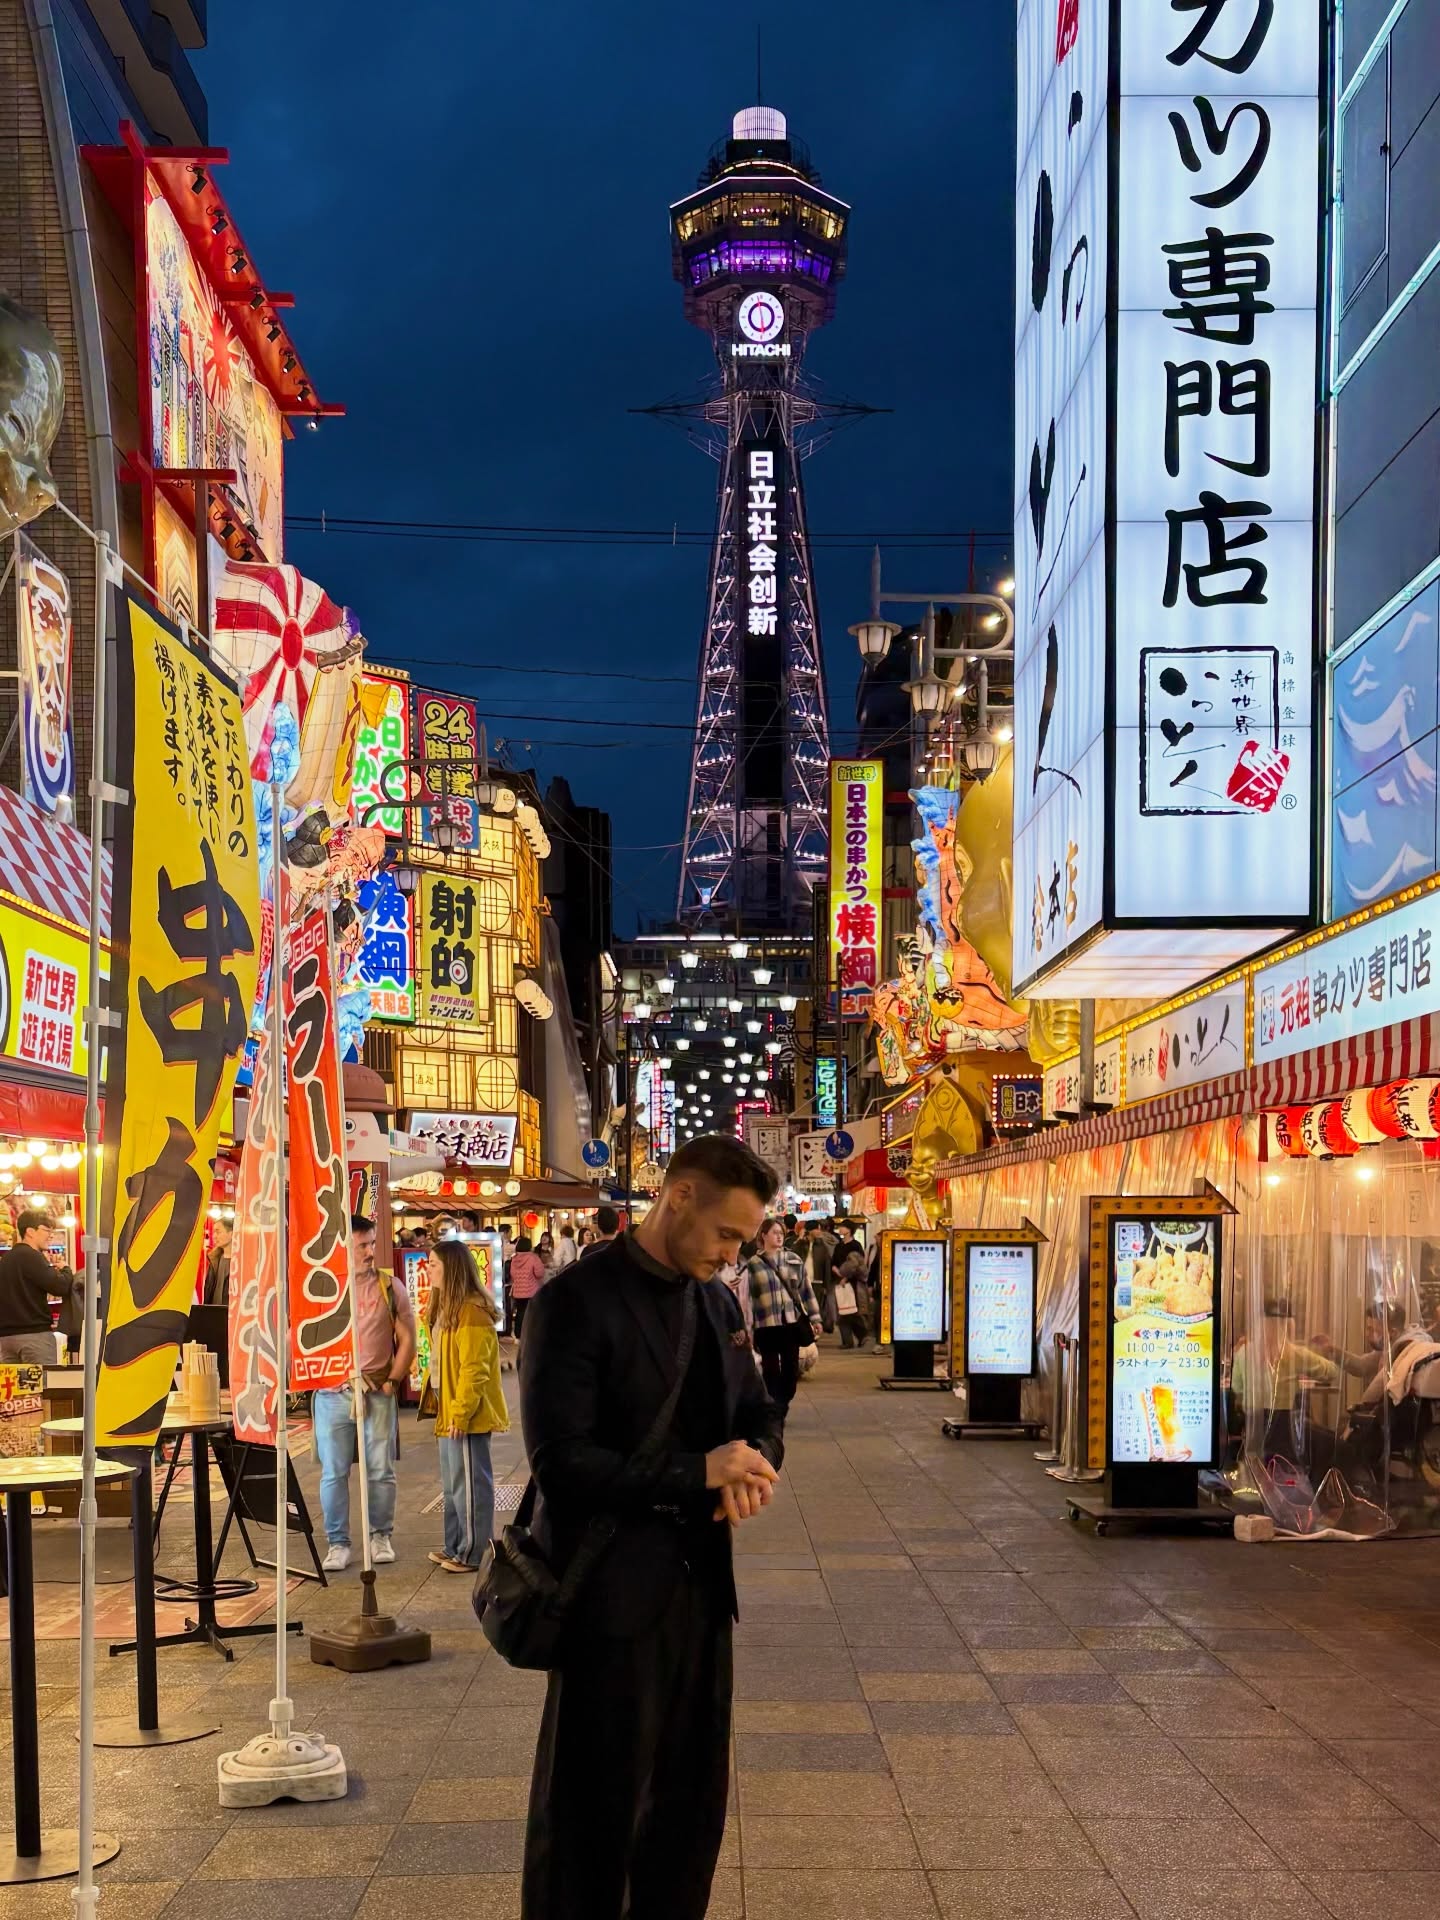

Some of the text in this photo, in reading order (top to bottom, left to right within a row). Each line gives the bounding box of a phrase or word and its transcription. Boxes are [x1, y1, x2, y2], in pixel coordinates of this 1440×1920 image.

[1161, 0, 1275, 607] カツ専門店
[731, 343, 790, 356] HITACHI
[748, 451, 777, 636] 日立社会创新
[154, 638, 186, 806] 揚げます。
[424, 700, 474, 743] 24
[1230, 669, 1262, 736] 新世界
[1282, 651, 1296, 747] 商標登録
[194, 671, 221, 844] 素材を使い
[218, 696, 249, 858] こだわりの
[837, 765, 876, 782] 新世界
[845, 784, 868, 902] 日本一の串かつ
[430, 879, 478, 996] 射的
[836, 904, 878, 989] 横綱
[1280, 928, 1432, 1035] 元祖串カツ専門店
[25, 957, 76, 1017] 新世界
[428, 1005, 475, 1021] チャンピオン
[20, 1011, 74, 1069] 遊技場
[287, 954, 352, 1355] ラーメン
[1116, 1357, 1210, 1368] ラストオーダー 23:30
[1142, 1329, 1186, 1340] 営業時間
